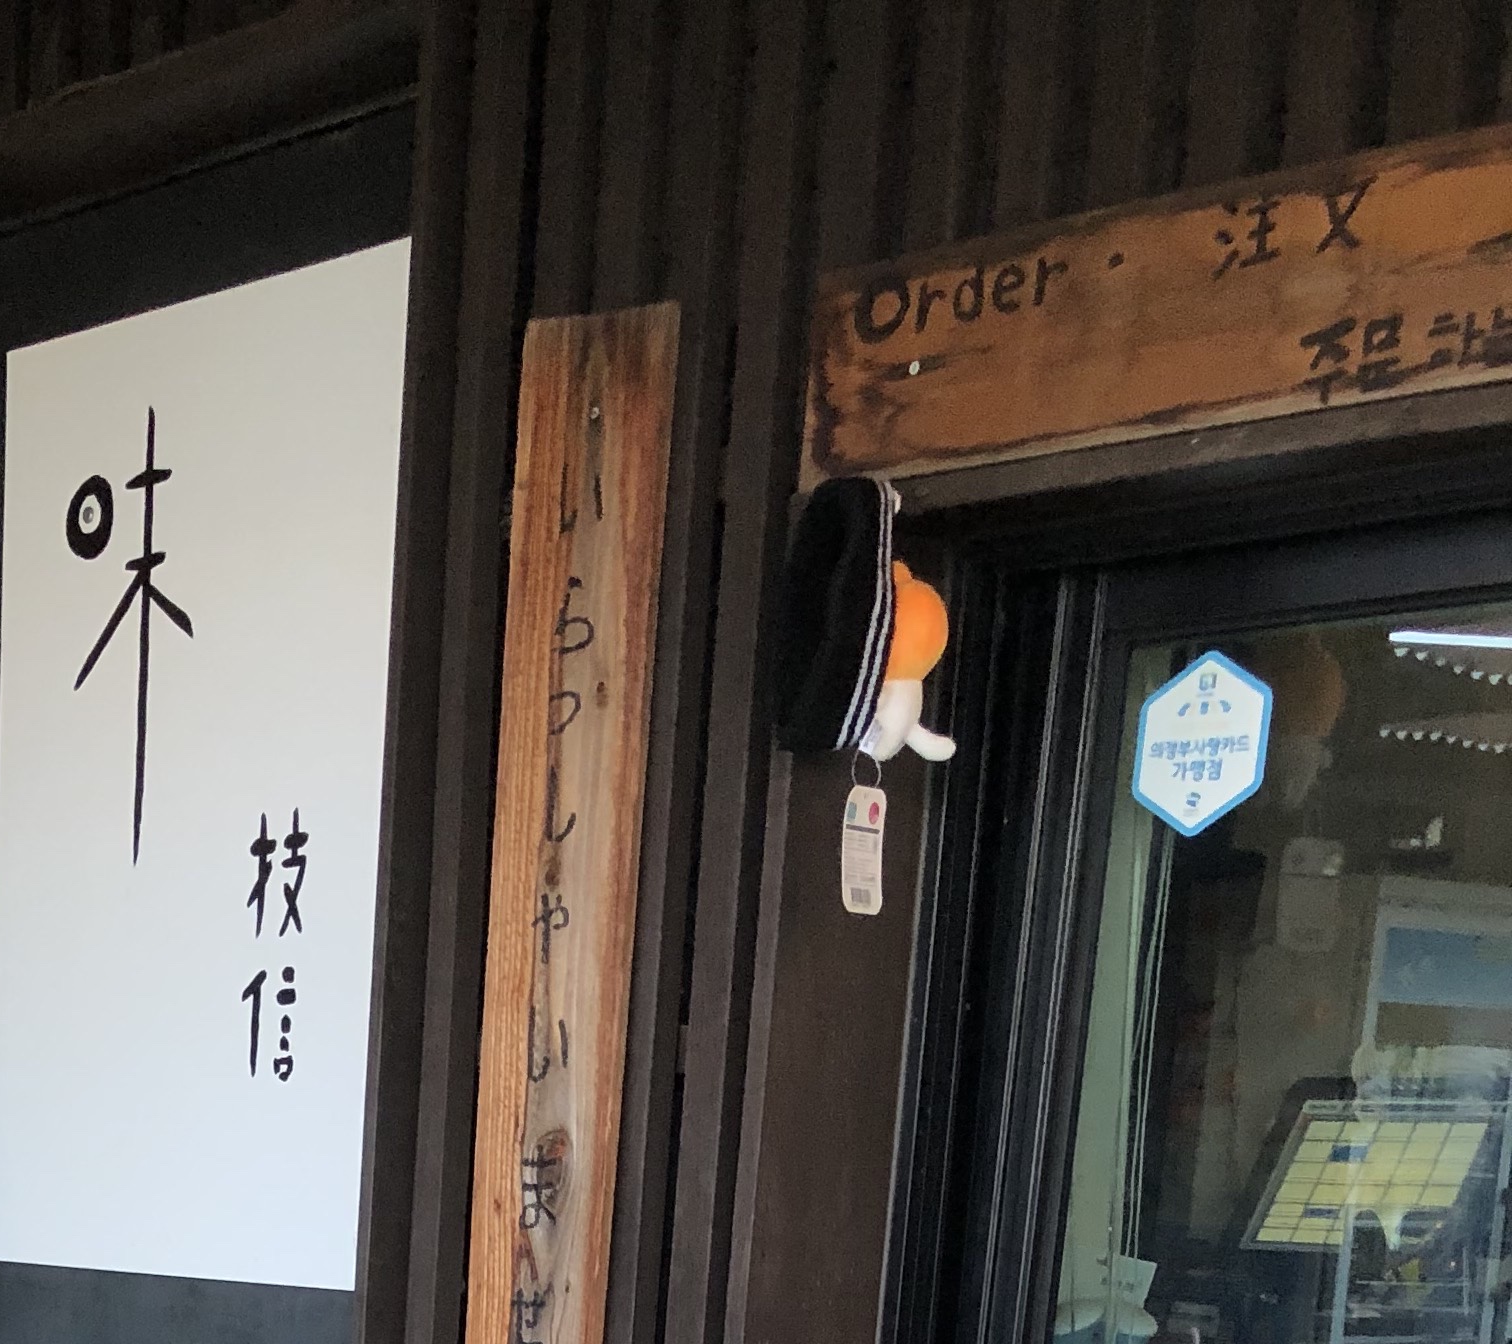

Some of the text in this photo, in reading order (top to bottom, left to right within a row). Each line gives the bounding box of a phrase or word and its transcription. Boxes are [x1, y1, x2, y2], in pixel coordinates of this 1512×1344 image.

[852, 255, 1069, 345] Order
[65, 404, 194, 868] 味
[1172, 758, 1223, 782] 가맹점
